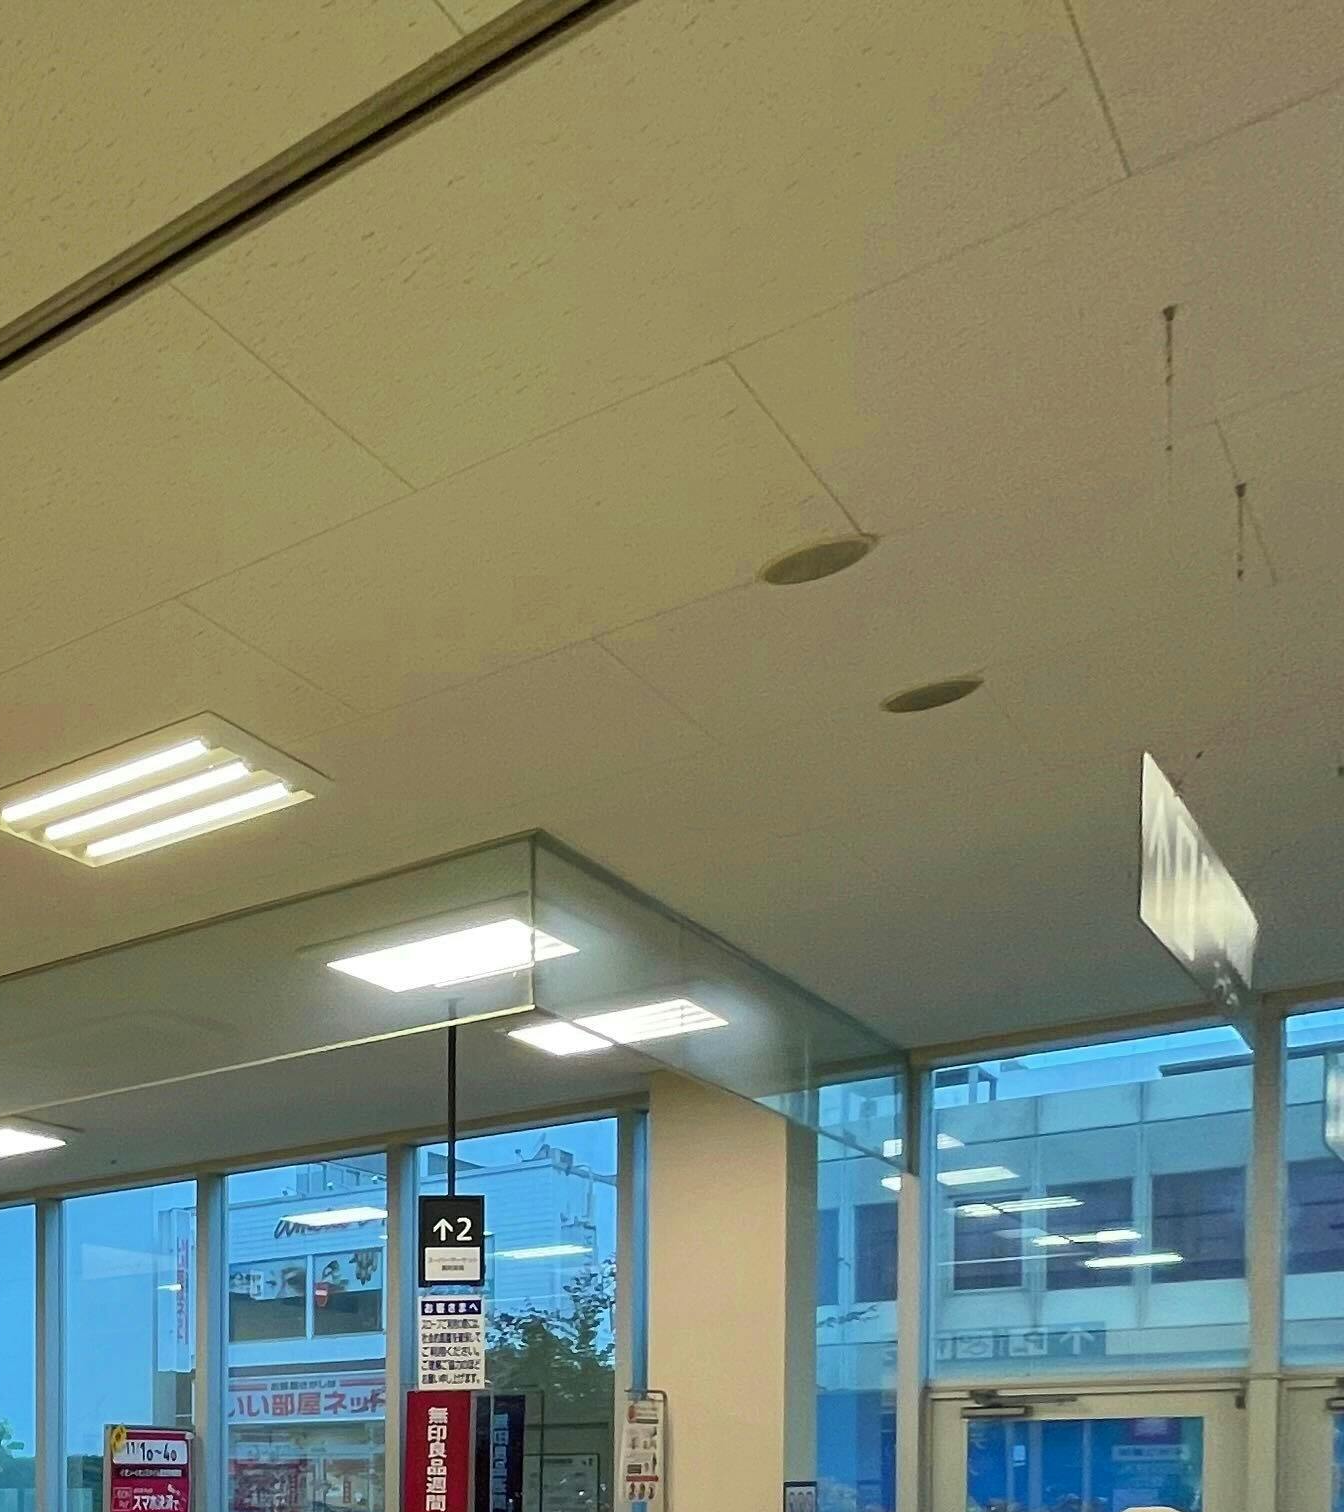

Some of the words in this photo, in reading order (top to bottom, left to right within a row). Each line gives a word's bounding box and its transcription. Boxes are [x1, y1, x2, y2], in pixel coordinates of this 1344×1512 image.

[456, 1217, 473, 1241] 2
[426, 1407, 449, 1512] 無印良品週間
